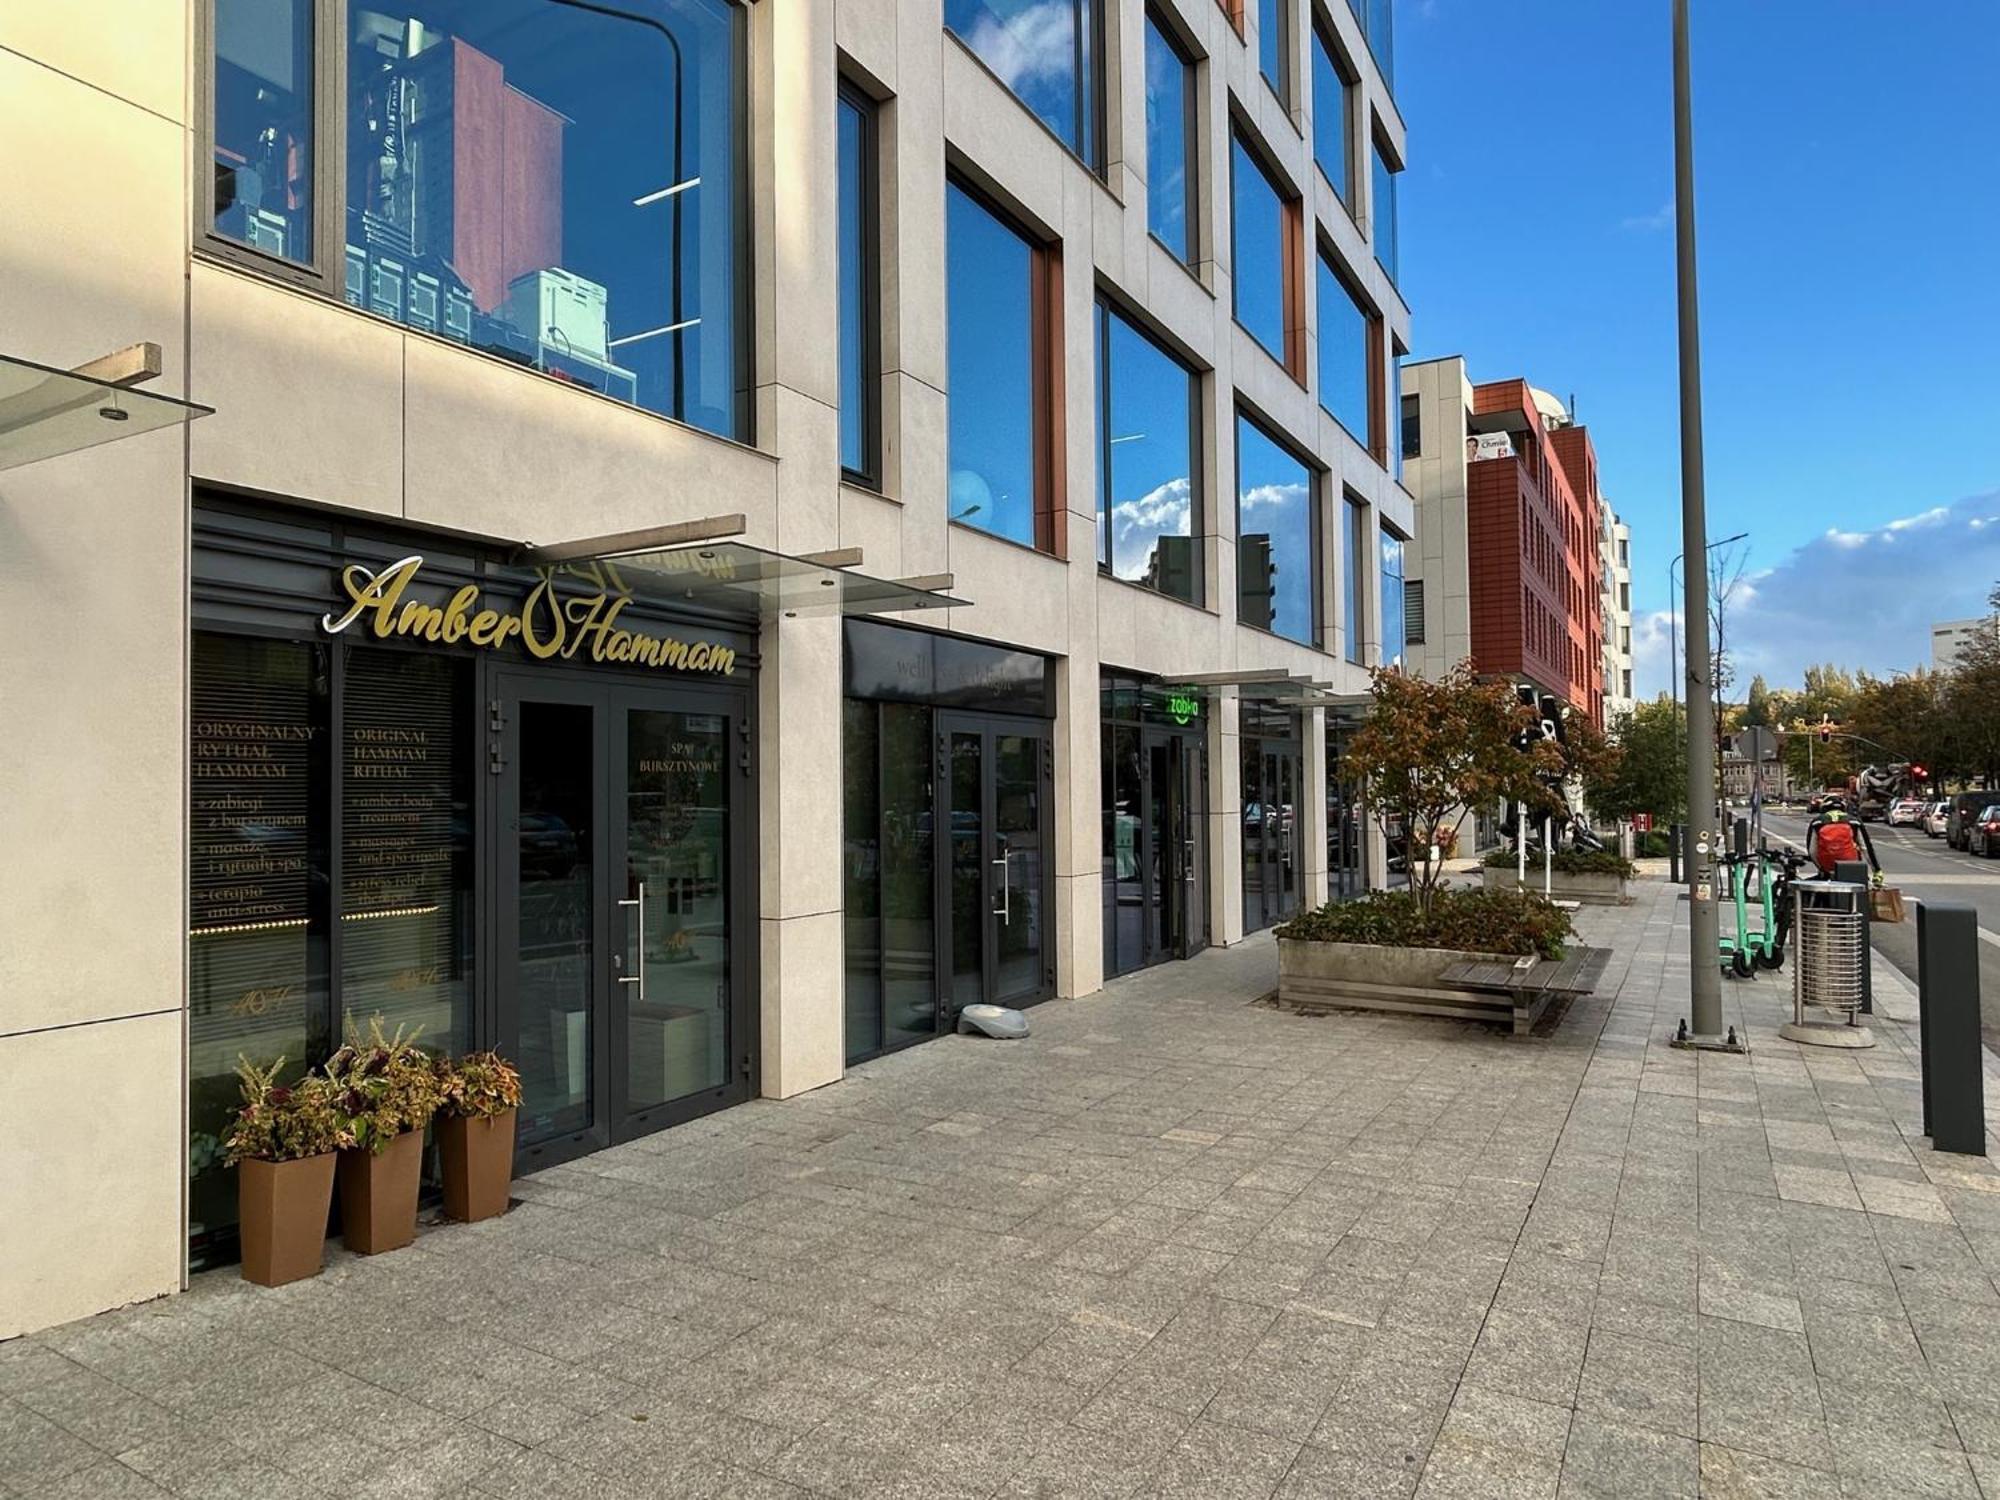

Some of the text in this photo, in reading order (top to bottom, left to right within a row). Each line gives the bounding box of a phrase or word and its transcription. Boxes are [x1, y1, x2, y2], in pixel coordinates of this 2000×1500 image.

[321, 555, 736, 675] Amber Hammam
[354, 747, 426, 760] HAMMAM
[198, 763, 287, 777] HAMMAM
[354, 765, 411, 778] RITUAL
